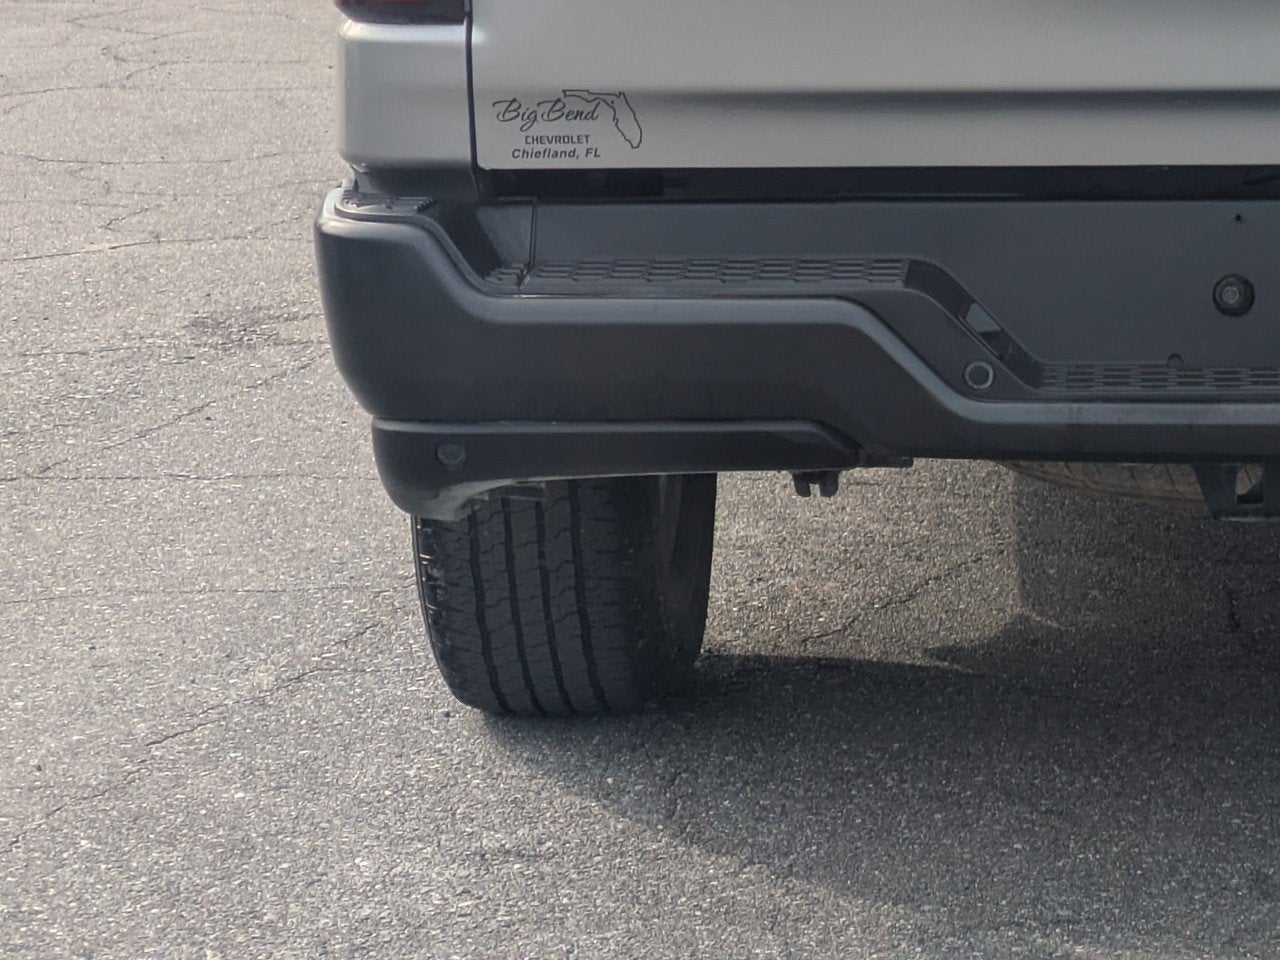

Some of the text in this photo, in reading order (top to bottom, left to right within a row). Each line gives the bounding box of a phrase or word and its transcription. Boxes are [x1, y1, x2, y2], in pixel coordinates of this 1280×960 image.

[492, 97, 601, 132] Big Bend
[524, 134, 590, 145] CHEVROLET
[511, 147, 601, 160] Chiefland, FL
